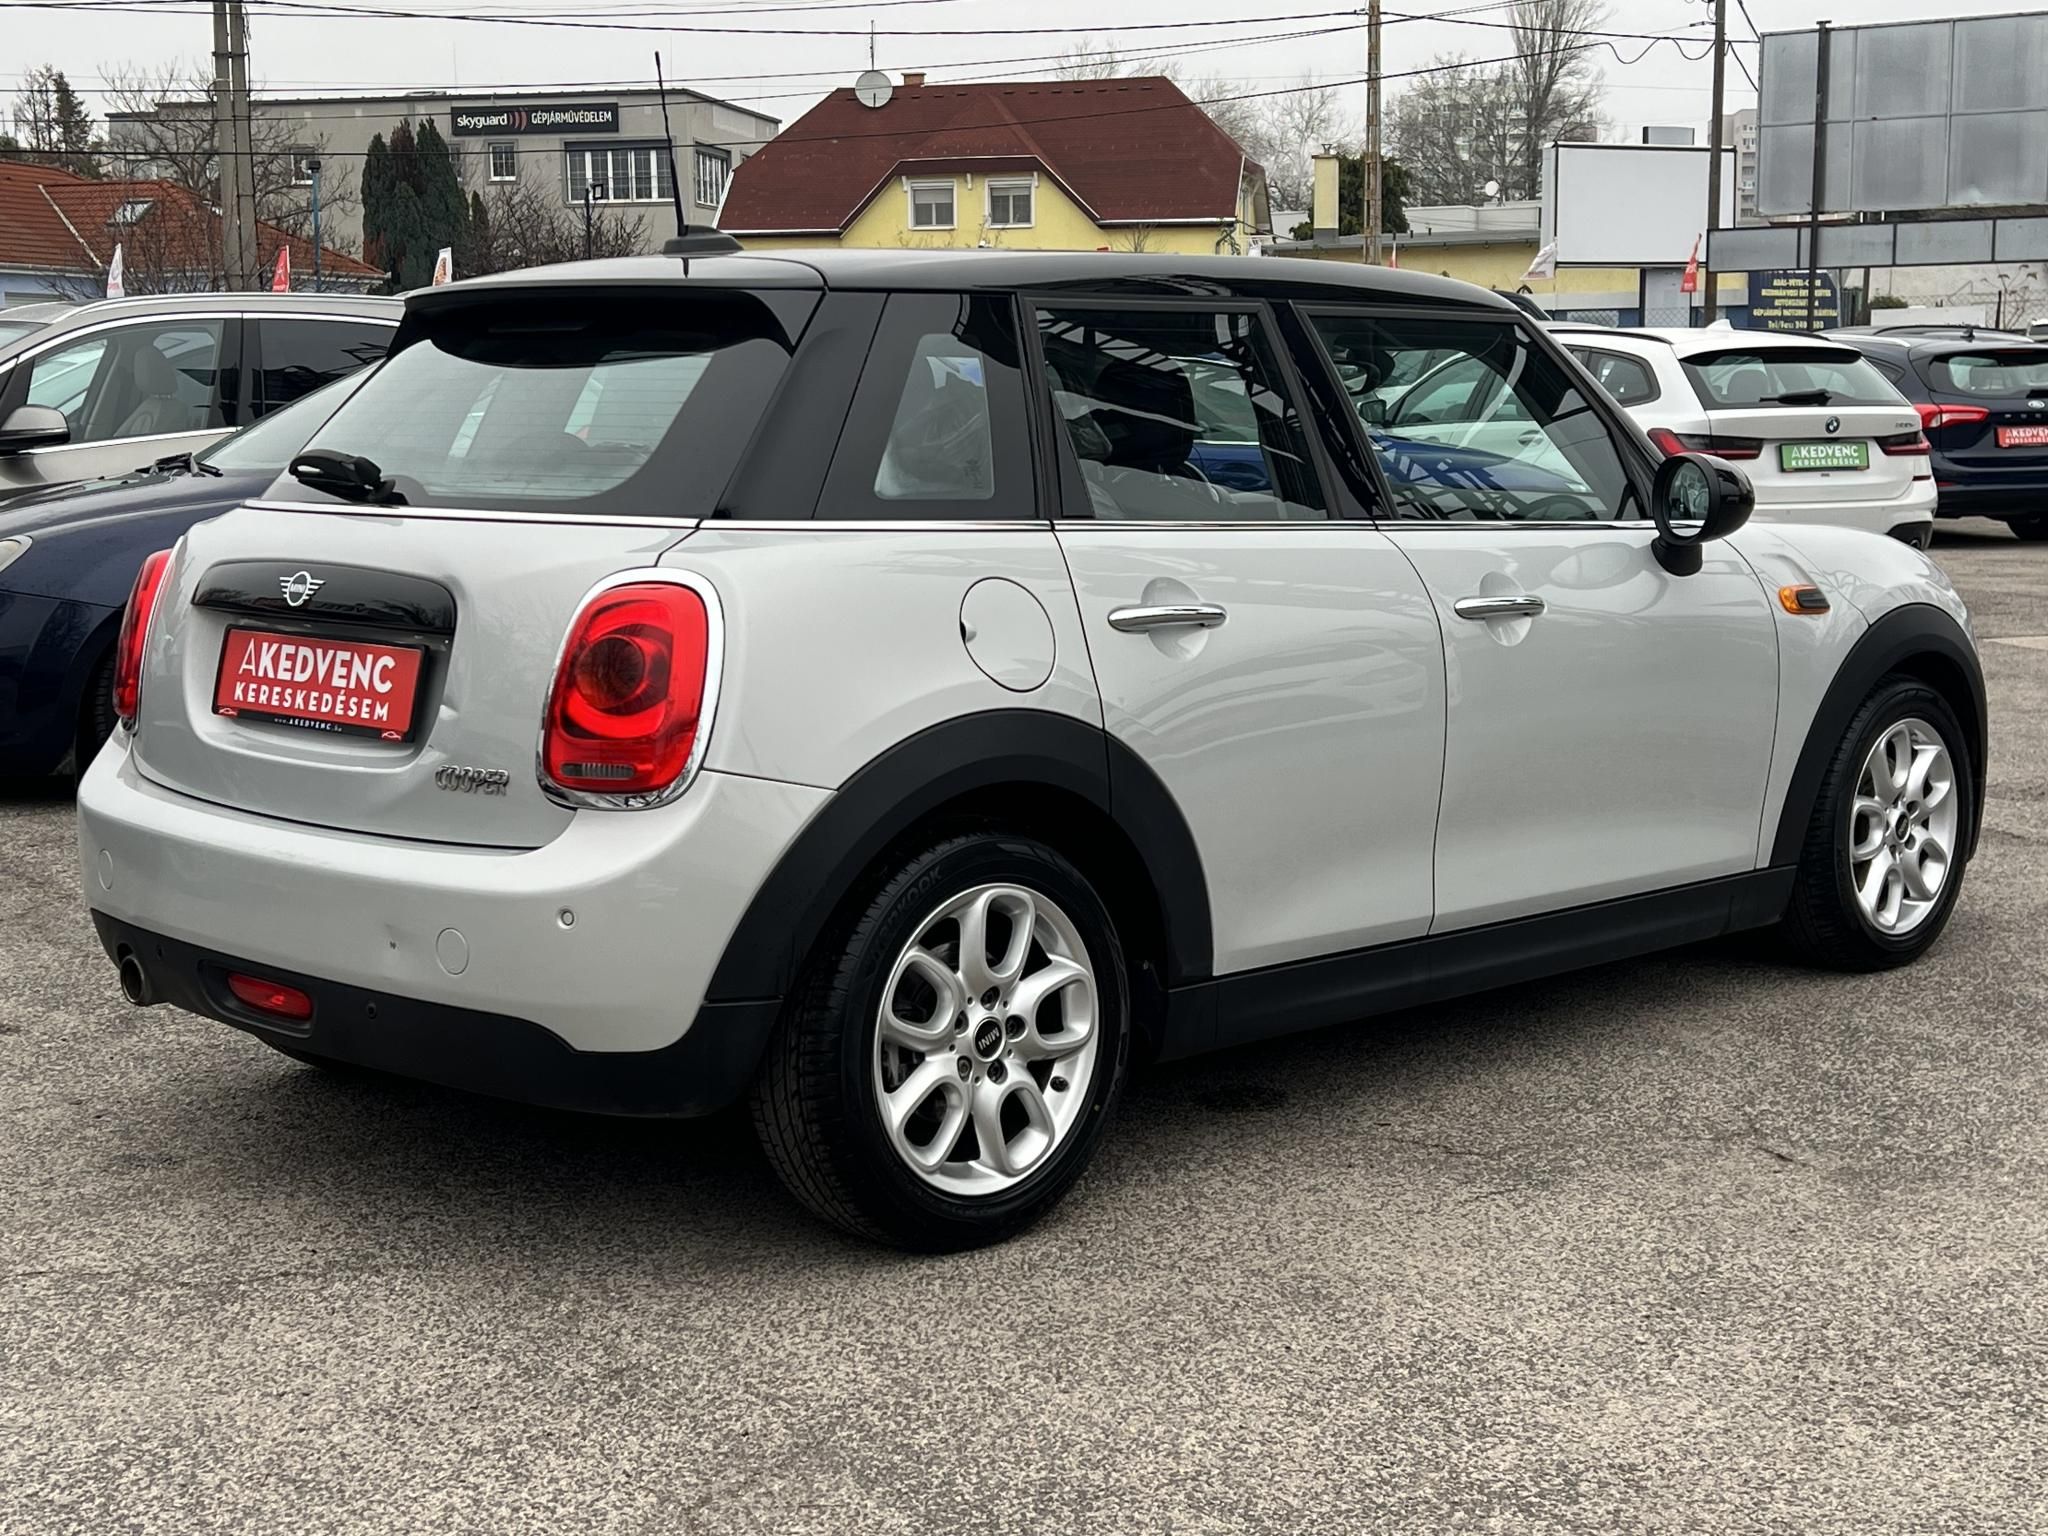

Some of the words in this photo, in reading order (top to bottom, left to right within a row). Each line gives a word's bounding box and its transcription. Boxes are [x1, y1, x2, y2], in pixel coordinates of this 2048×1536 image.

[457, 113, 508, 129] skyguard
[531, 110, 612, 126] GÉPJÁRMŰVÉDELEM
[2005, 427, 2048, 437] AKEDVEN
[1791, 446, 1859, 459] AKEDVENC
[238, 638, 396, 694] AKEDVENC
[234, 681, 389, 722] KERESKEDÉSEM
[435, 765, 509, 796] COOPER
